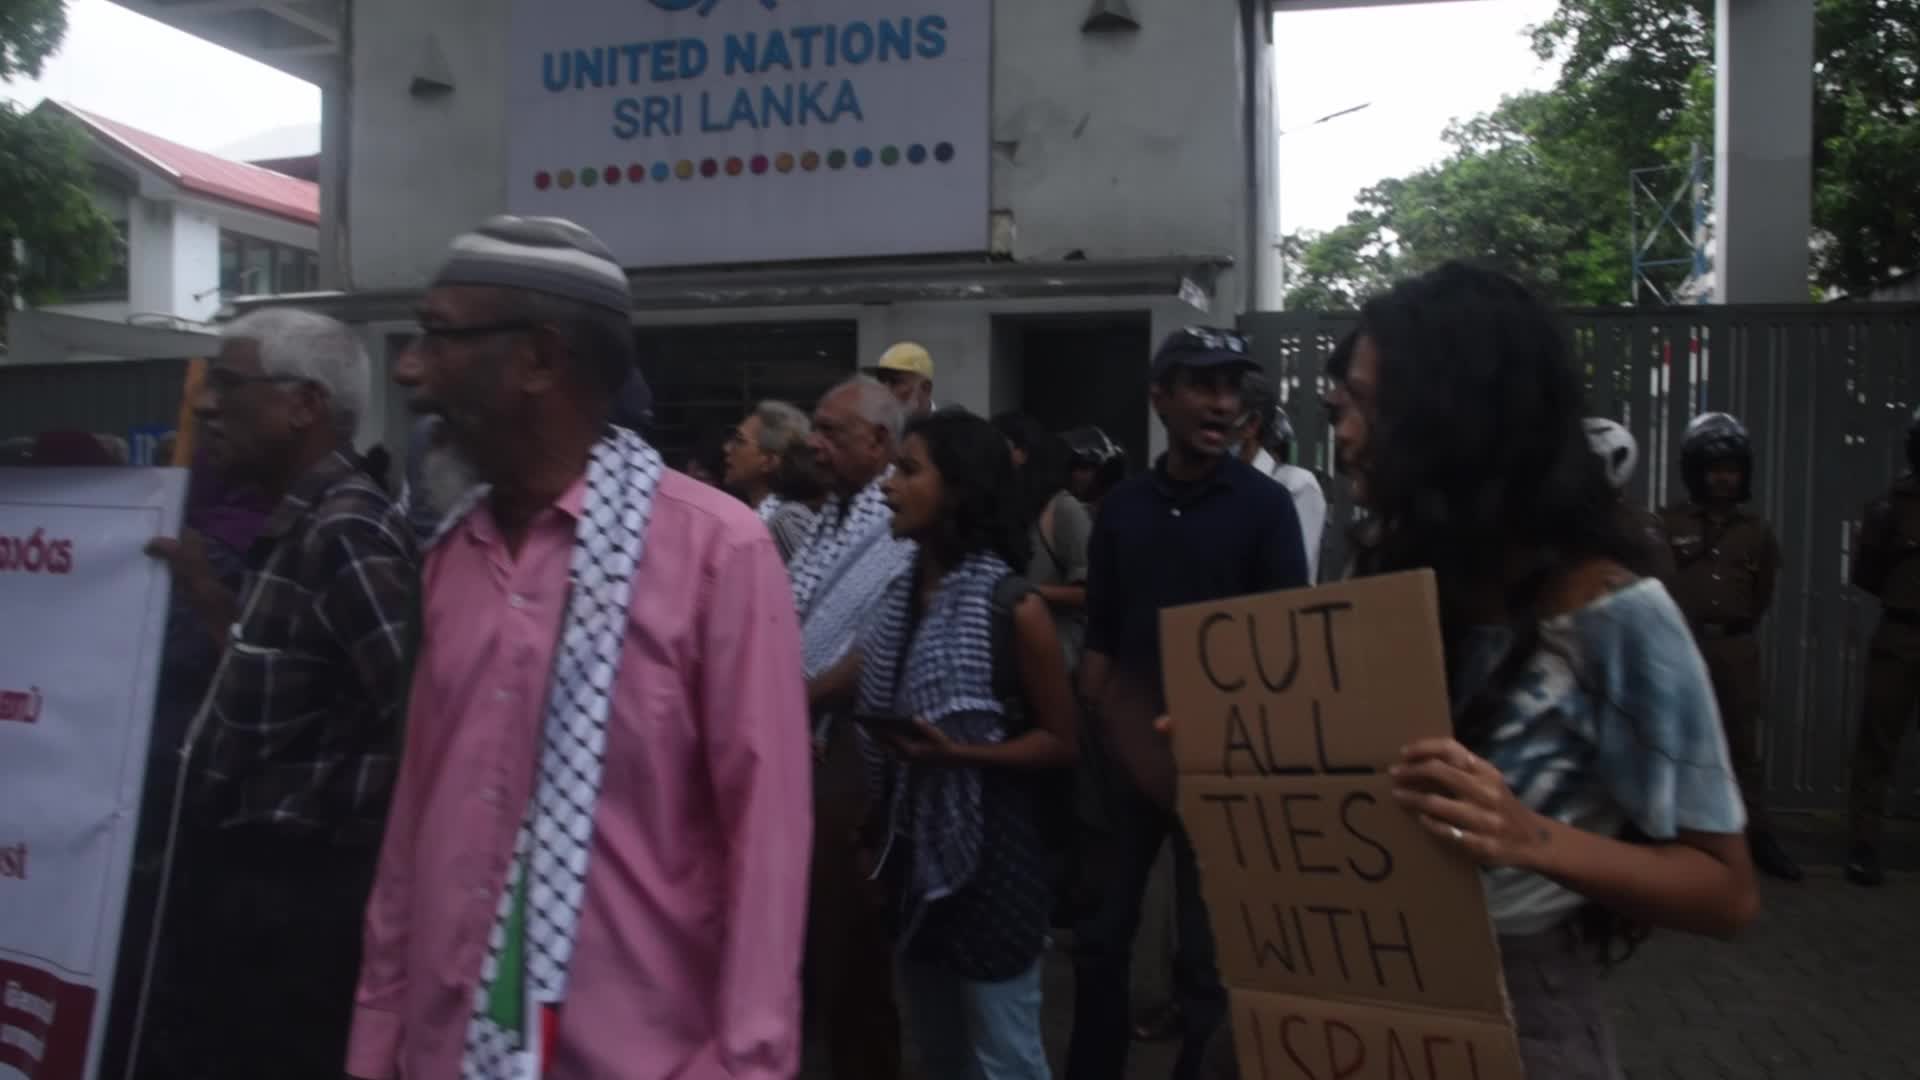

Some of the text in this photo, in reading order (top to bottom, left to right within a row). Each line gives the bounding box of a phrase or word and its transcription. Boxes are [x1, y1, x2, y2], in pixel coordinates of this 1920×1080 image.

[543, 15, 948, 92] UNITED NATIONS
[612, 79, 863, 140] SRI LANKA
[1197, 601, 1353, 693] CUT
[1222, 700, 1376, 778] ALL
[1200, 791, 1394, 882] TIES
[1240, 903, 1424, 992] WITH
